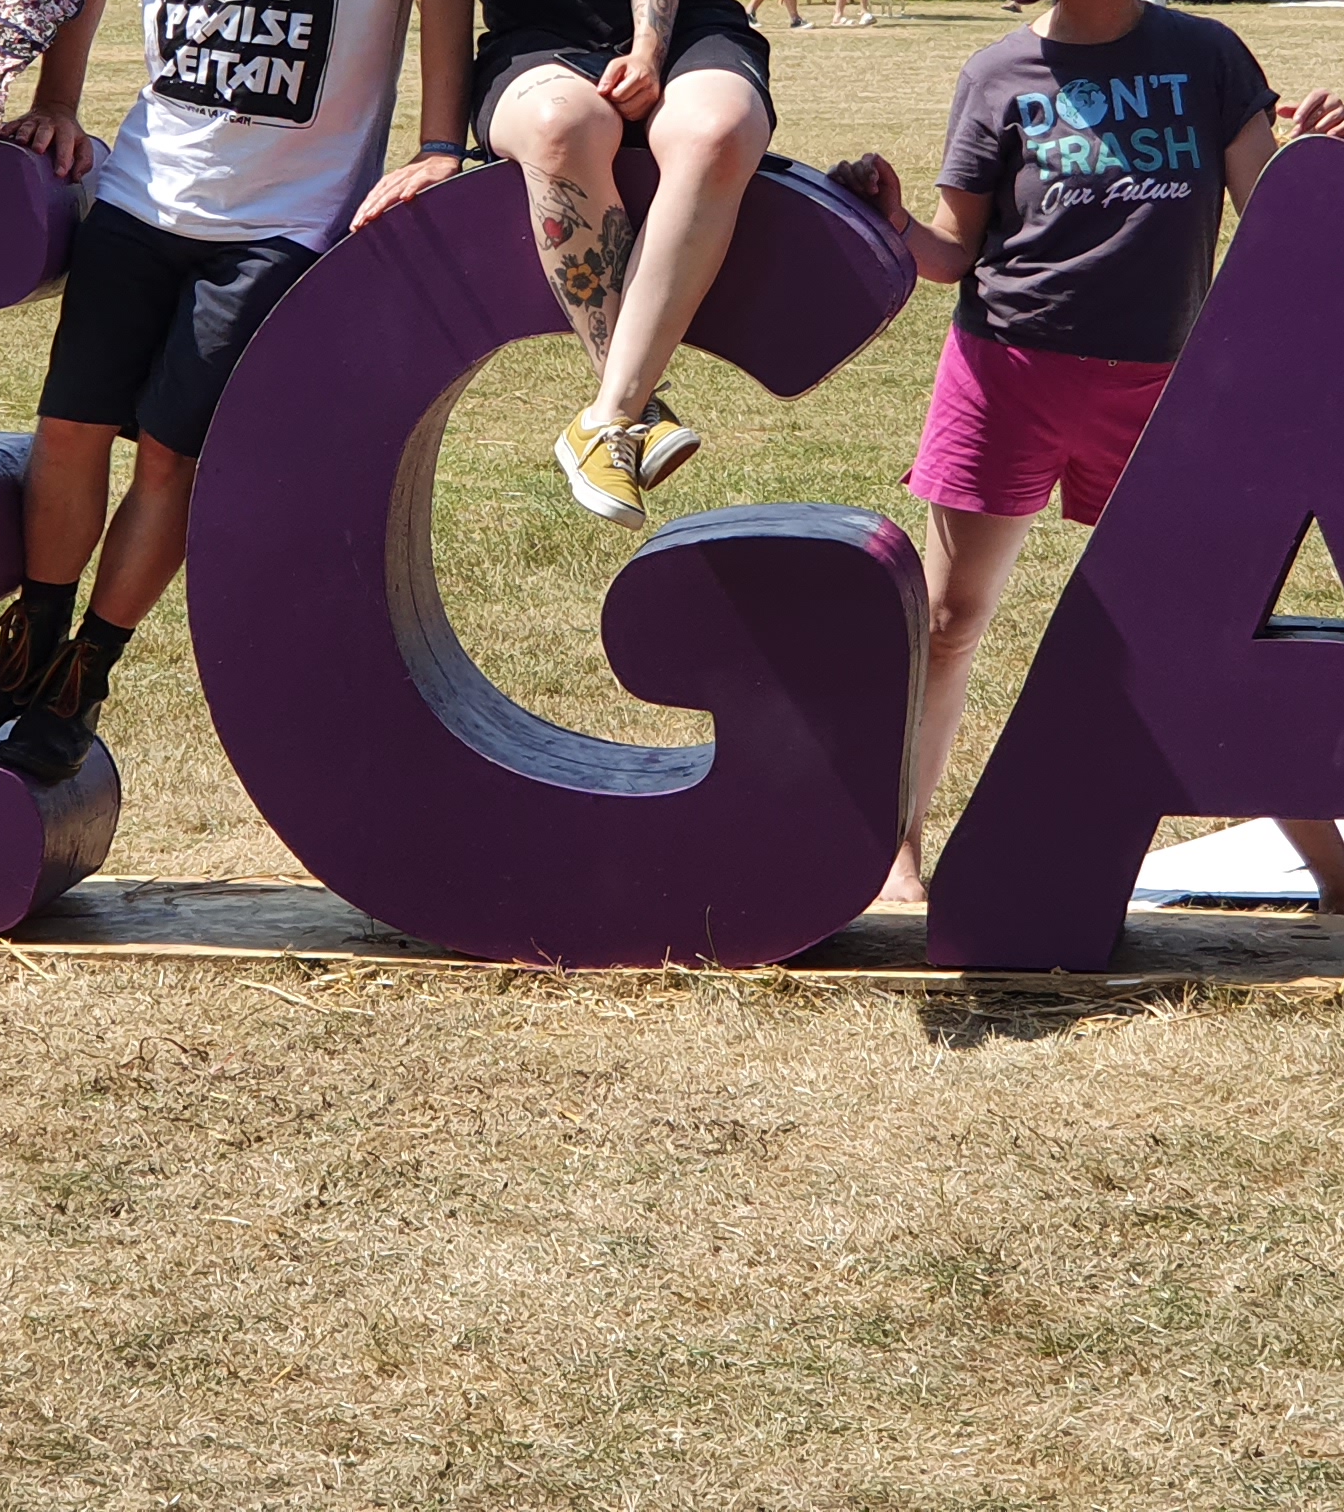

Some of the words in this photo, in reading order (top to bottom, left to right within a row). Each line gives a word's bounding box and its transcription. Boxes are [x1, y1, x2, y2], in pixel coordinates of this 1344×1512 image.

[166, 3, 313, 49] PRAISE
[1016, 74, 1188, 136] DON'T
[1026, 126, 1200, 180] TRASH
[1041, 182, 1095, 215] Our
[1101, 176, 1192, 208] Future
